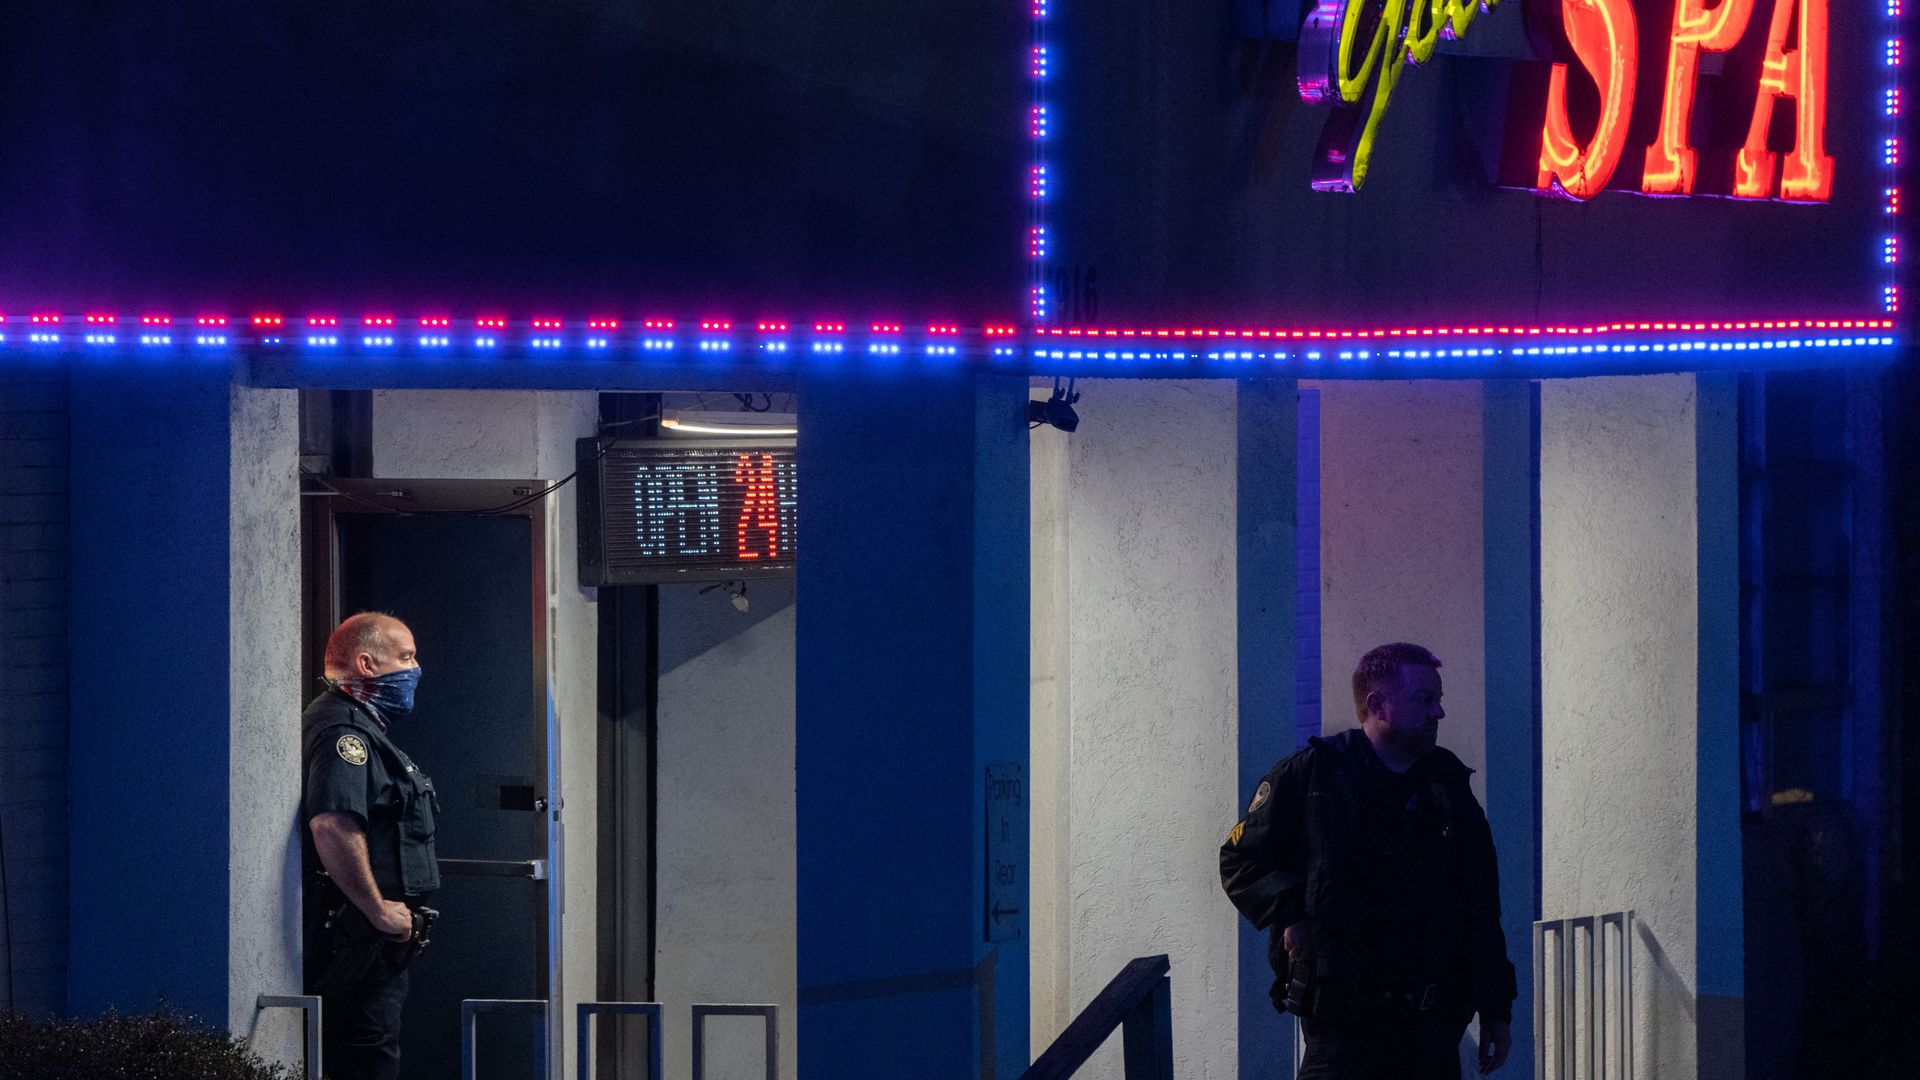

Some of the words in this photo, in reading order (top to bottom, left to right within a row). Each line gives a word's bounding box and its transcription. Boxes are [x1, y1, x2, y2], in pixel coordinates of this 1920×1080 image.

[1537, 0, 1836, 200] SPA
[1046, 265, 1098, 322] 916
[634, 464, 721, 556] OPEN
[735, 454, 778, 559] 24
[988, 773, 1022, 807] Parking
[995, 859, 1017, 886] Rear
